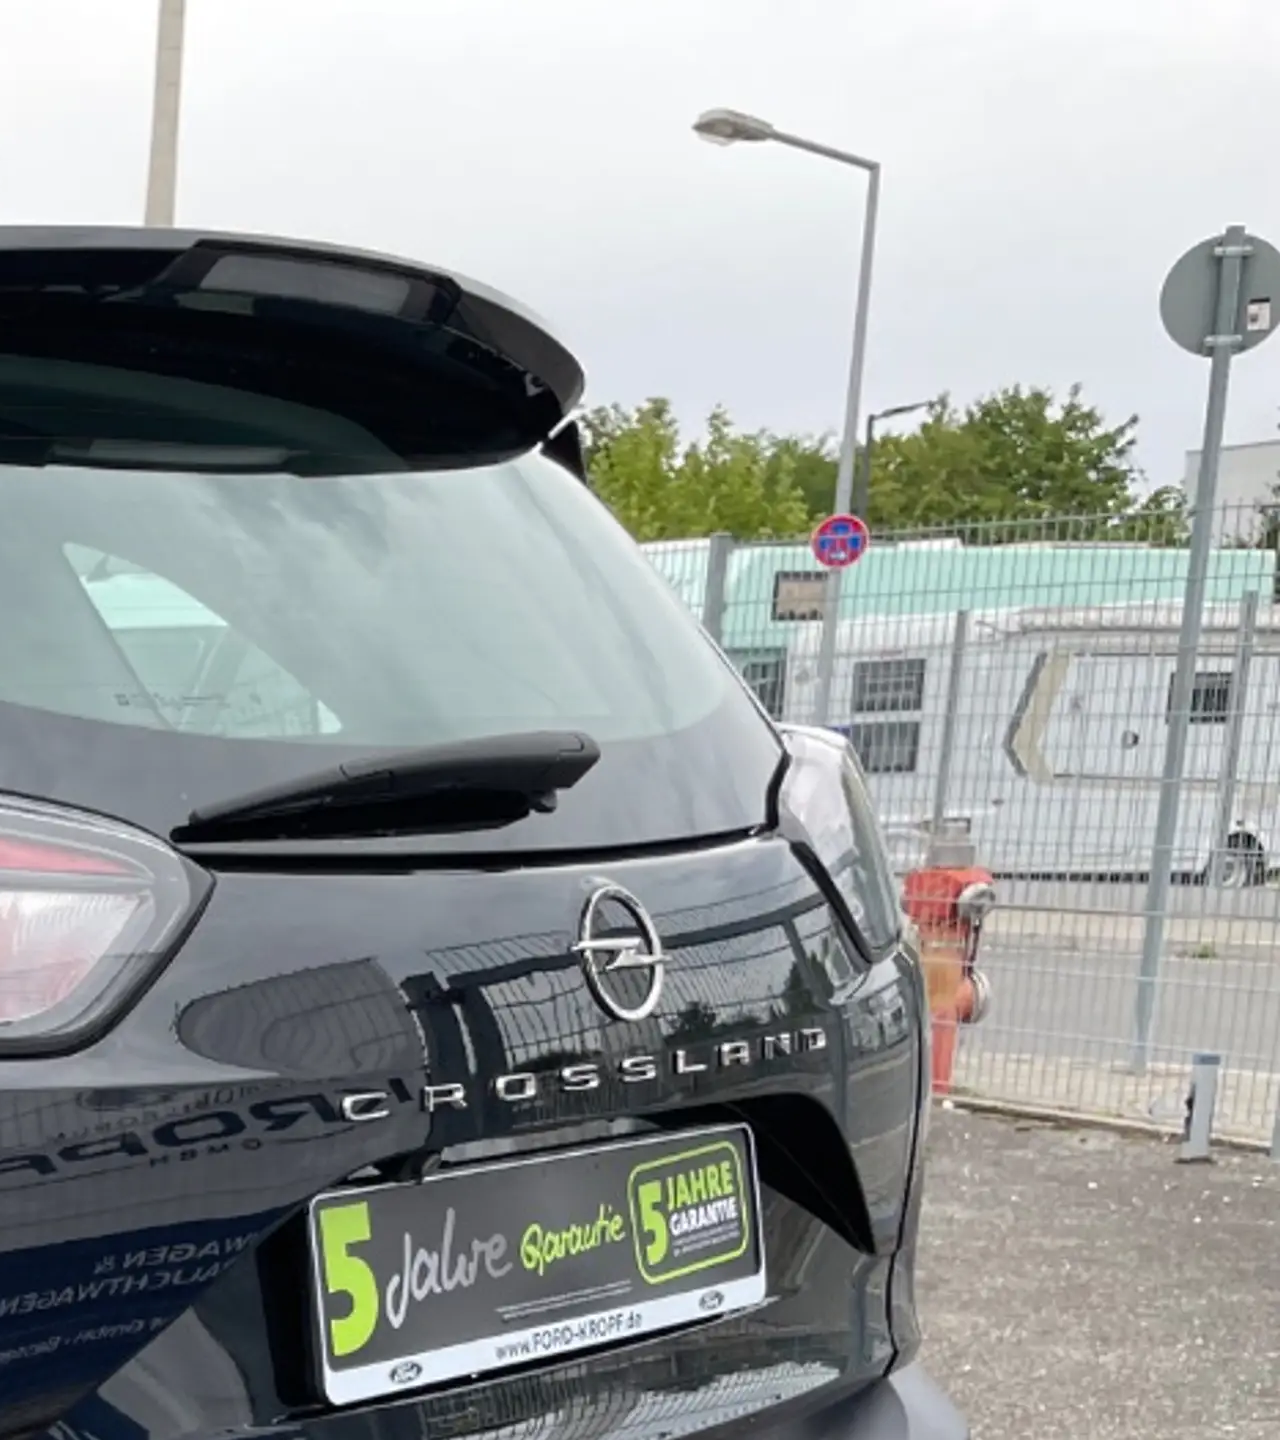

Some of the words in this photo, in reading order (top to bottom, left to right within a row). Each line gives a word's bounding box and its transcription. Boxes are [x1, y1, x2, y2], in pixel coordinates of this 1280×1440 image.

[343, 1027, 827, 1122] CROSSLAND
[666, 1160, 734, 1211] JAHRE
[669, 1196, 739, 1236] GARANTIE
[638, 1181, 668, 1266] 5
[319, 1201, 379, 1357] 5
[385, 1207, 514, 1329] Jahre
[519, 1203, 626, 1275] Garantie
[495, 1313, 643, 1361] www.FORD-KROPF.de
